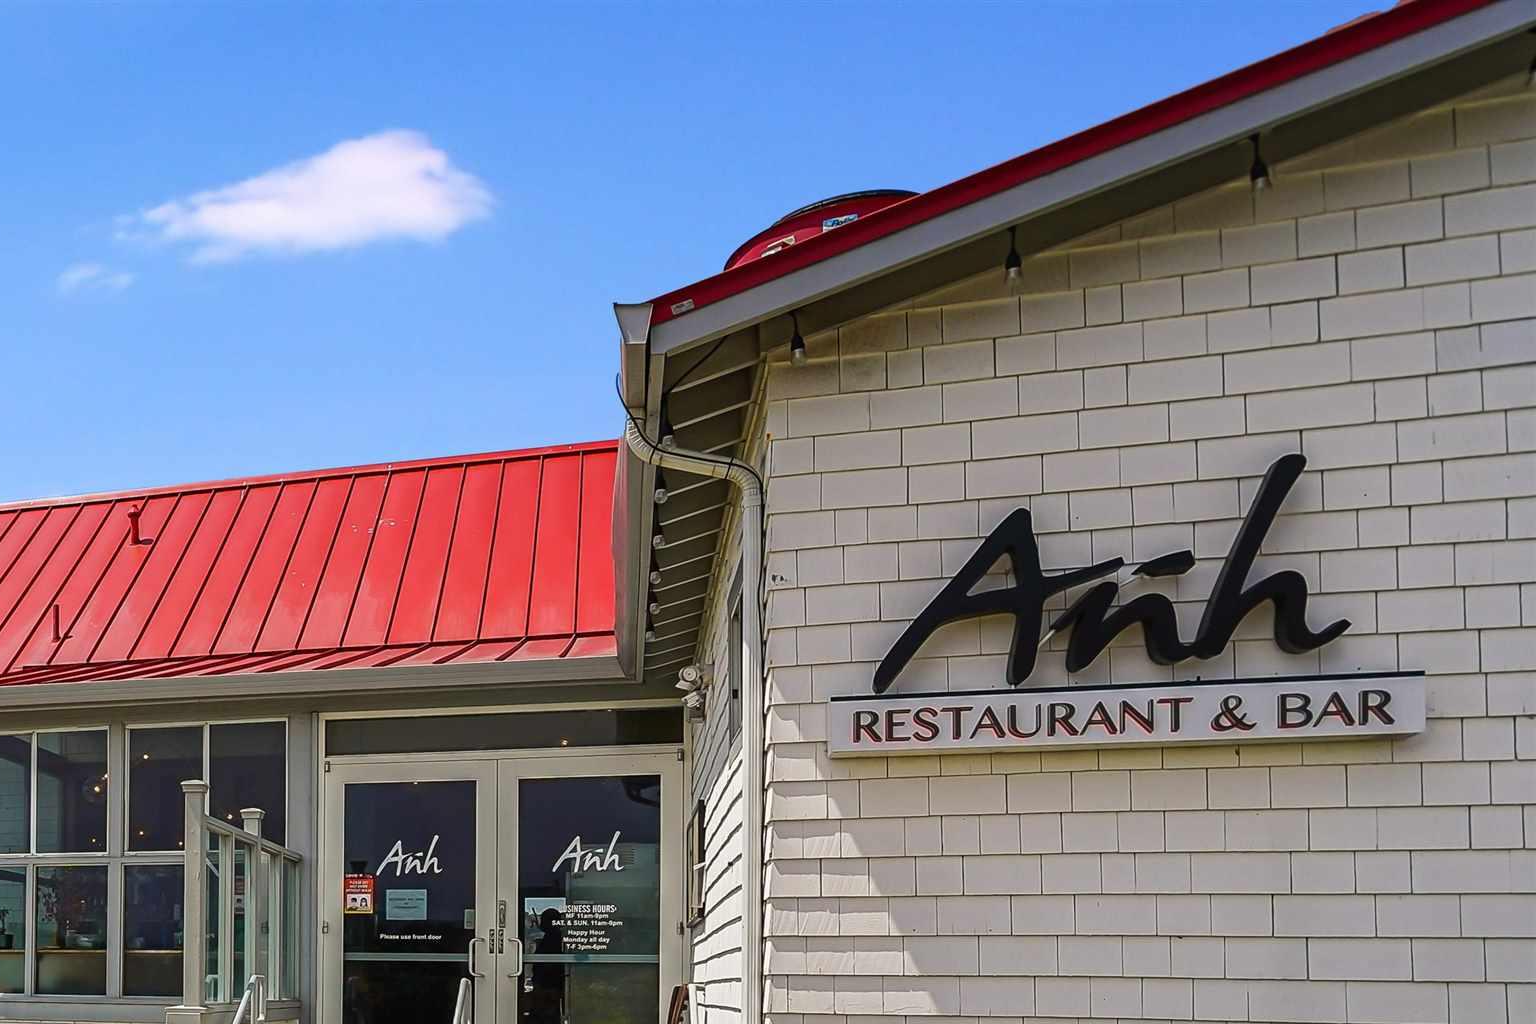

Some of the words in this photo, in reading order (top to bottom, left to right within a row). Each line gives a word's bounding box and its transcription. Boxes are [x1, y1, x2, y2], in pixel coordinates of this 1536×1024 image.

[852, 696, 1193, 744] RESTAURANT
[1210, 695, 1257, 732] &
[1276, 689, 1396, 730] BAR
